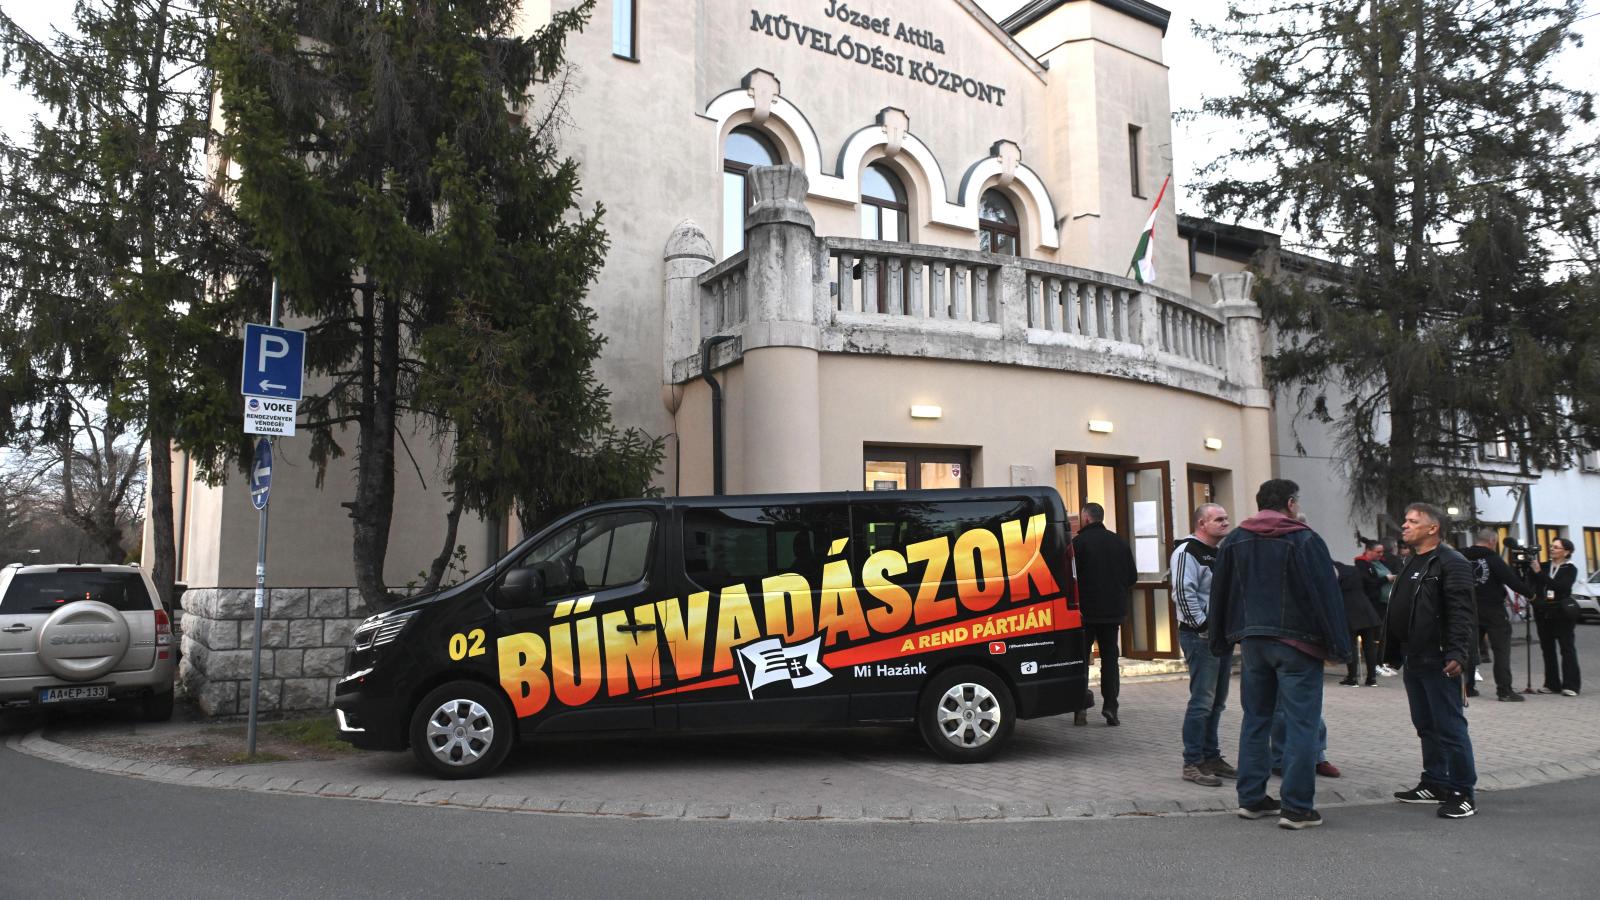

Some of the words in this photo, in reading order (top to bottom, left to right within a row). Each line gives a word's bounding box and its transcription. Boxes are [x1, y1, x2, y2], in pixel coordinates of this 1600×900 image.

[824, 0, 890, 36] József
[894, 22, 945, 55] Attila
[750, 10, 904, 76] MŰVELŐDÉSI
[909, 60, 1005, 106] KÖZPONT
[259, 334, 289, 372] P
[263, 402, 293, 413] VOKE
[50, 633, 120, 645] SUZUKI
[449, 628, 486, 662] 02
[901, 639, 915, 652] A
[918, 627, 969, 649] REND
[972, 607, 1052, 639] PÁRTJÁN
[854, 665, 872, 678] Mi
[876, 661, 927, 677] Hazánk
